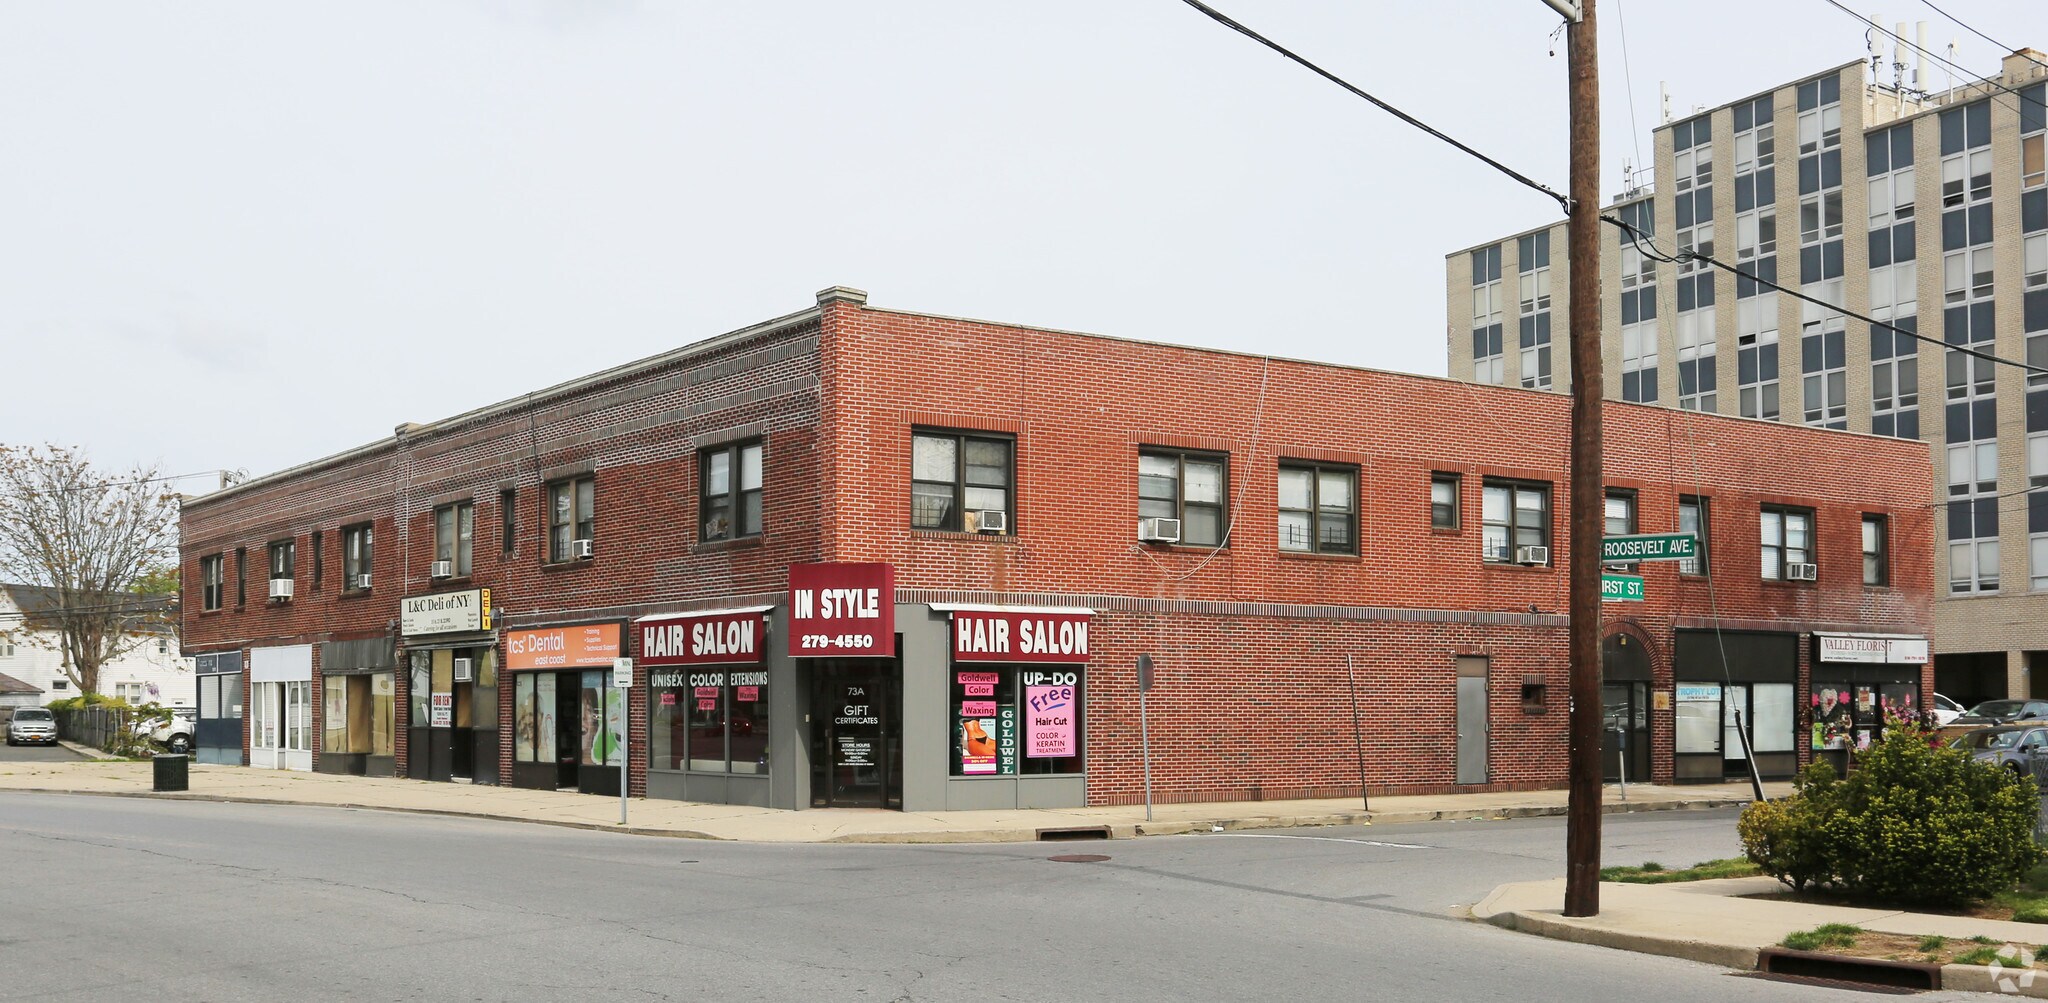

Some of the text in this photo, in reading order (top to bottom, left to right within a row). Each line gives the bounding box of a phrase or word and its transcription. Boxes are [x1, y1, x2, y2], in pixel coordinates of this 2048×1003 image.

[1604, 539, 1692, 556] ROOSEVELT AVE.
[1602, 580, 1643, 595] IRST ST.
[408, 599, 426, 613] L&C
[428, 597, 444, 611] Deli
[445, 595, 455, 609] of
[482, 590, 490, 627] DELI
[794, 588, 879, 619] IN STYLE
[528, 632, 565, 652] Dental
[644, 620, 754, 657] HAIR SALON
[801, 634, 873, 649] 279-4550
[957, 618, 1088, 655] HAIR SALON
[1824, 639, 1892, 652] VALLEY FLORIST
[535, 654, 566, 665] east coast
[651, 673, 683, 687] UNISEX
[690, 673, 724, 687] COLOR
[730, 671, 768, 686] EXTENSIONS
[961, 674, 996, 682] Goldwell
[1023, 671, 1077, 686] UP-DO
[847, 687, 865, 696] 73A
[968, 686, 990, 694] Color
[1706, 687, 1720, 695] LOT
[1030, 688, 1072, 713] Free
[843, 705, 869, 716] GIFT
[964, 707, 995, 716] Waxing
[834, 717, 879, 725] CERTIFICATES
[1035, 717, 1068, 726] Hair Cut
